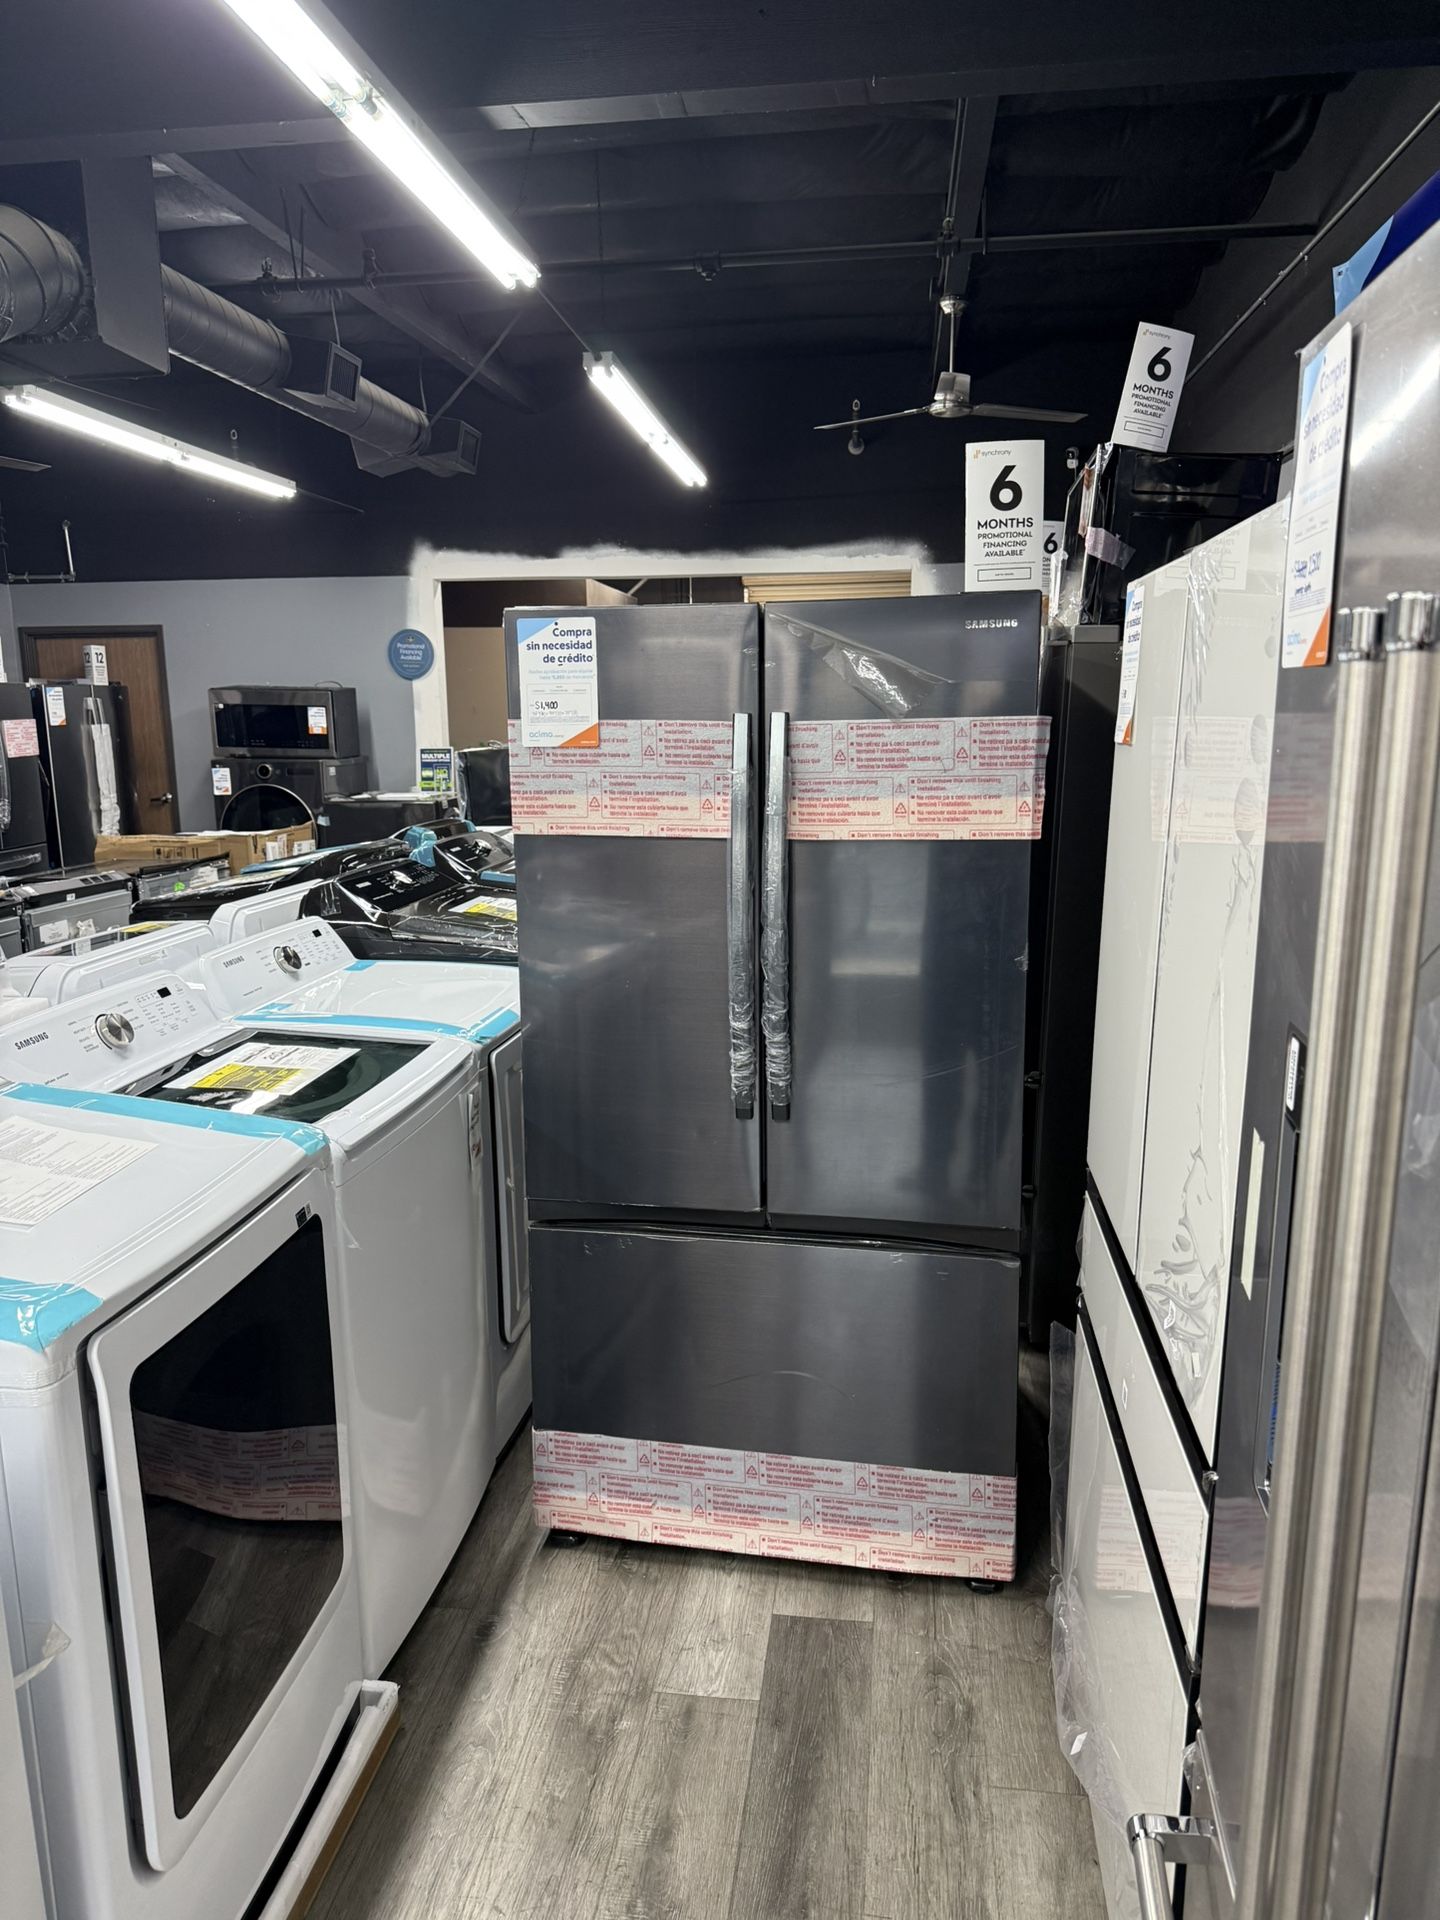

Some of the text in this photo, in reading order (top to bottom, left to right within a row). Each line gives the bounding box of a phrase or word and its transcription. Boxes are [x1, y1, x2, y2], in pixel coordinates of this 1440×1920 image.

[1147, 346, 1172, 382] 6
[1133, 384, 1174, 400] MONTHS
[1131, 393, 1171, 407] PROMOTIONAL
[1133, 400, 1166, 413] FINANCING
[981, 449, 1011, 458] synchrony
[989, 464, 1023, 511] 6
[977, 517, 1034, 530] MONTHS
[977, 531, 1033, 540] PROMOTIONAL
[983, 540, 1027, 549] FINANCING
[1043, 532, 1058, 555] 6
[965, 618, 1018, 629] SAMSUNG
[552, 628, 592, 639] Compra
[526, 640, 593, 651] sin necesidad
[95, 652, 104, 664] 12
[542, 653, 594, 663] de crédito
[223, 955, 245, 968] SAMSUNG
[14, 1031, 49, 1050] SAMSUNG
